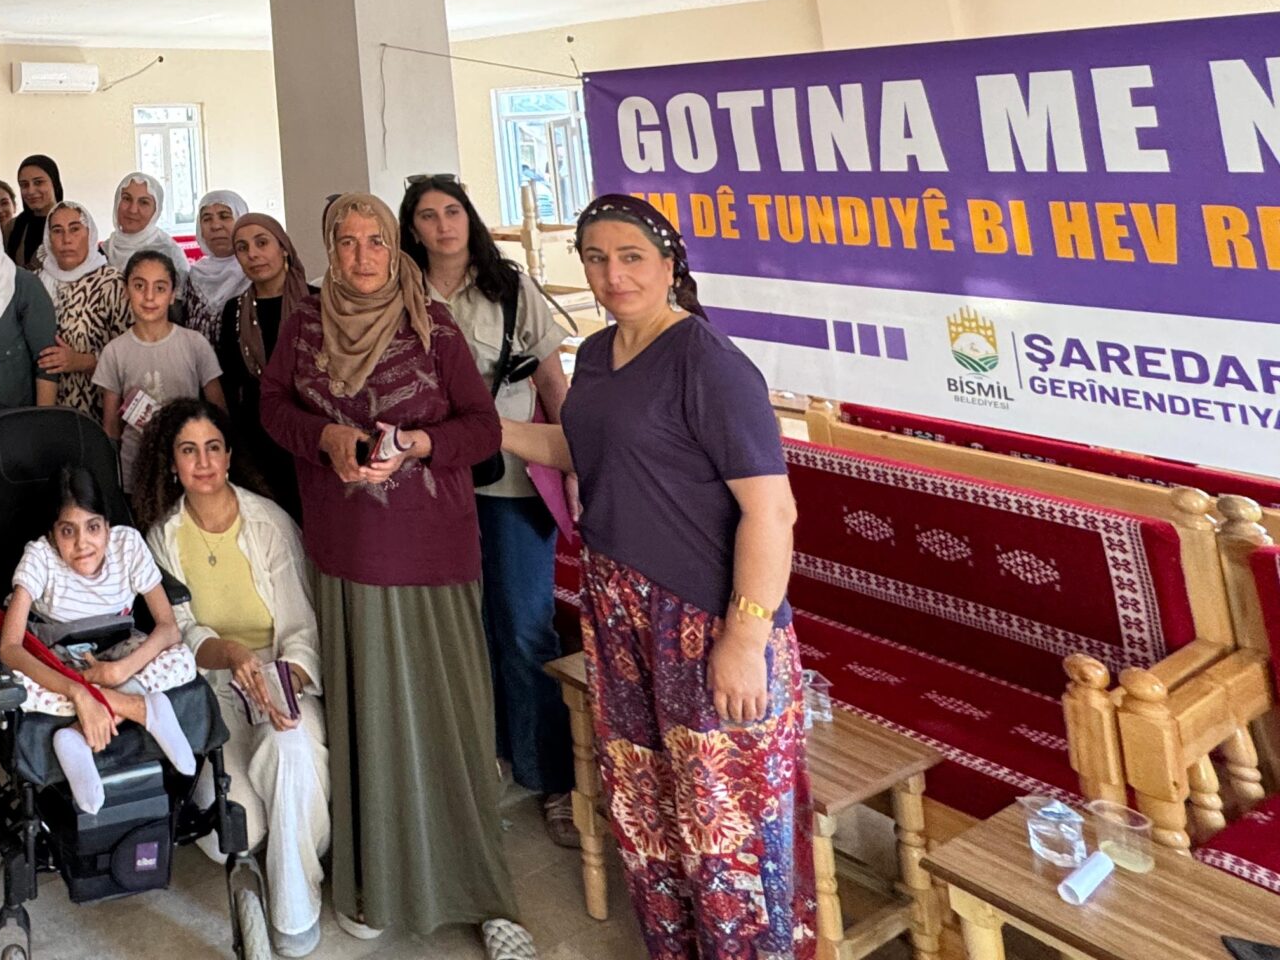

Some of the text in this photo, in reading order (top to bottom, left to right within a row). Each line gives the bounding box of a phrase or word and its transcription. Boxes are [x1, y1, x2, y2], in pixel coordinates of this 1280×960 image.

[617, 79, 949, 174] GOTINA
[976, 65, 1170, 172] ME
[689, 185, 740, 239] DÊ
[748, 188, 955, 252] TUNDIYÊ
[967, 199, 1034, 256] BI
[1048, 201, 1178, 265] HEV
[946, 376, 1015, 402] BİSMİL
